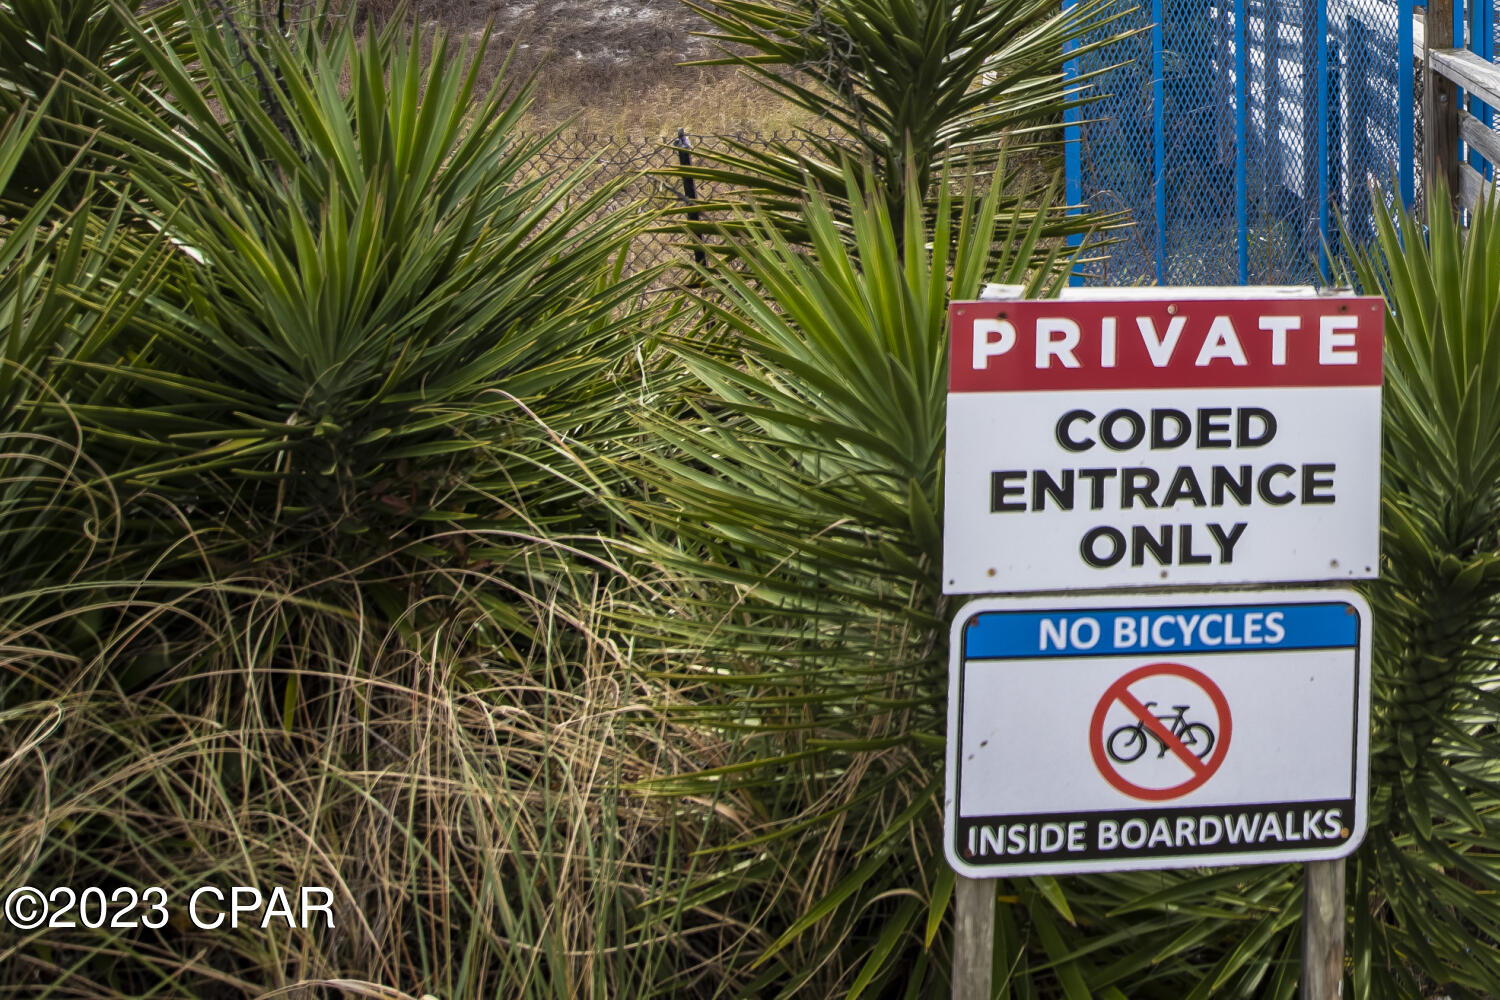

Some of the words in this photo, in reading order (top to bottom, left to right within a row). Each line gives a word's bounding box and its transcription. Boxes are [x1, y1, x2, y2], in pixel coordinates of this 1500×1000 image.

[971, 315, 1360, 370] PRIVATE
[1055, 407, 1278, 453] CODED
[989, 463, 1337, 514] ENTRANCE
[1079, 523, 1248, 568] ONLY
[1039, 617, 1100, 651] NO
[1113, 612, 1286, 650] BICYCLES
[968, 820, 1087, 857] INSIDE
[1097, 809, 1344, 850] BOARDWALKS
